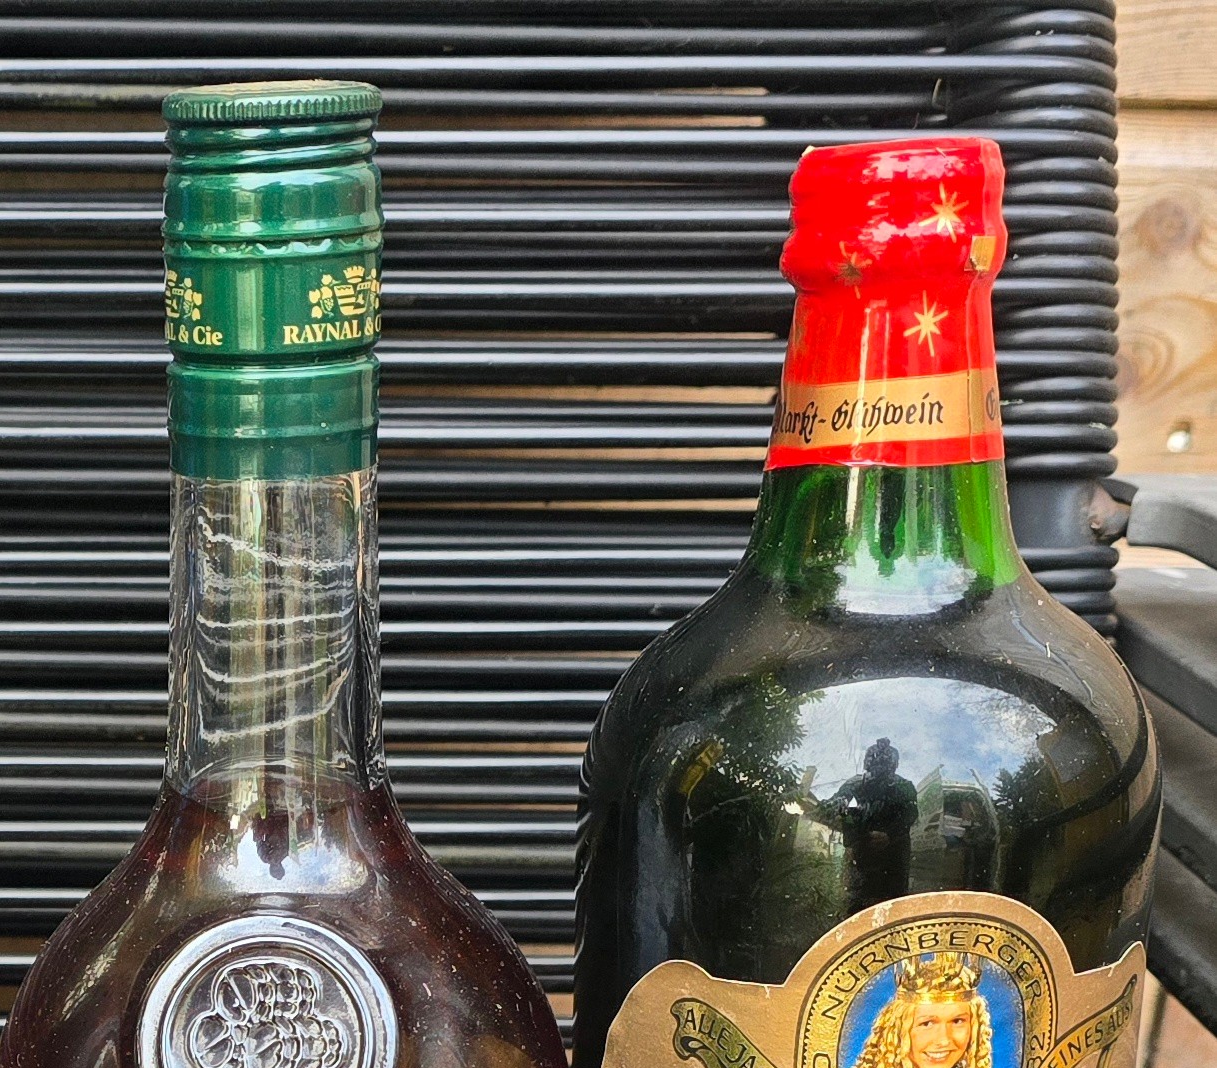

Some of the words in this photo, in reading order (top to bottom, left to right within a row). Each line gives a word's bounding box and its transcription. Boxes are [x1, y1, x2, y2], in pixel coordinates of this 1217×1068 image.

[178, 324, 189, 344] &
[193, 325, 223, 346] Cie
[283, 319, 362, 345] RAYNAL
[364, 316, 374, 336] &
[821, 930, 1042, 1020] NÜRNBERGER
[683, 1008, 733, 1050] ALLE
